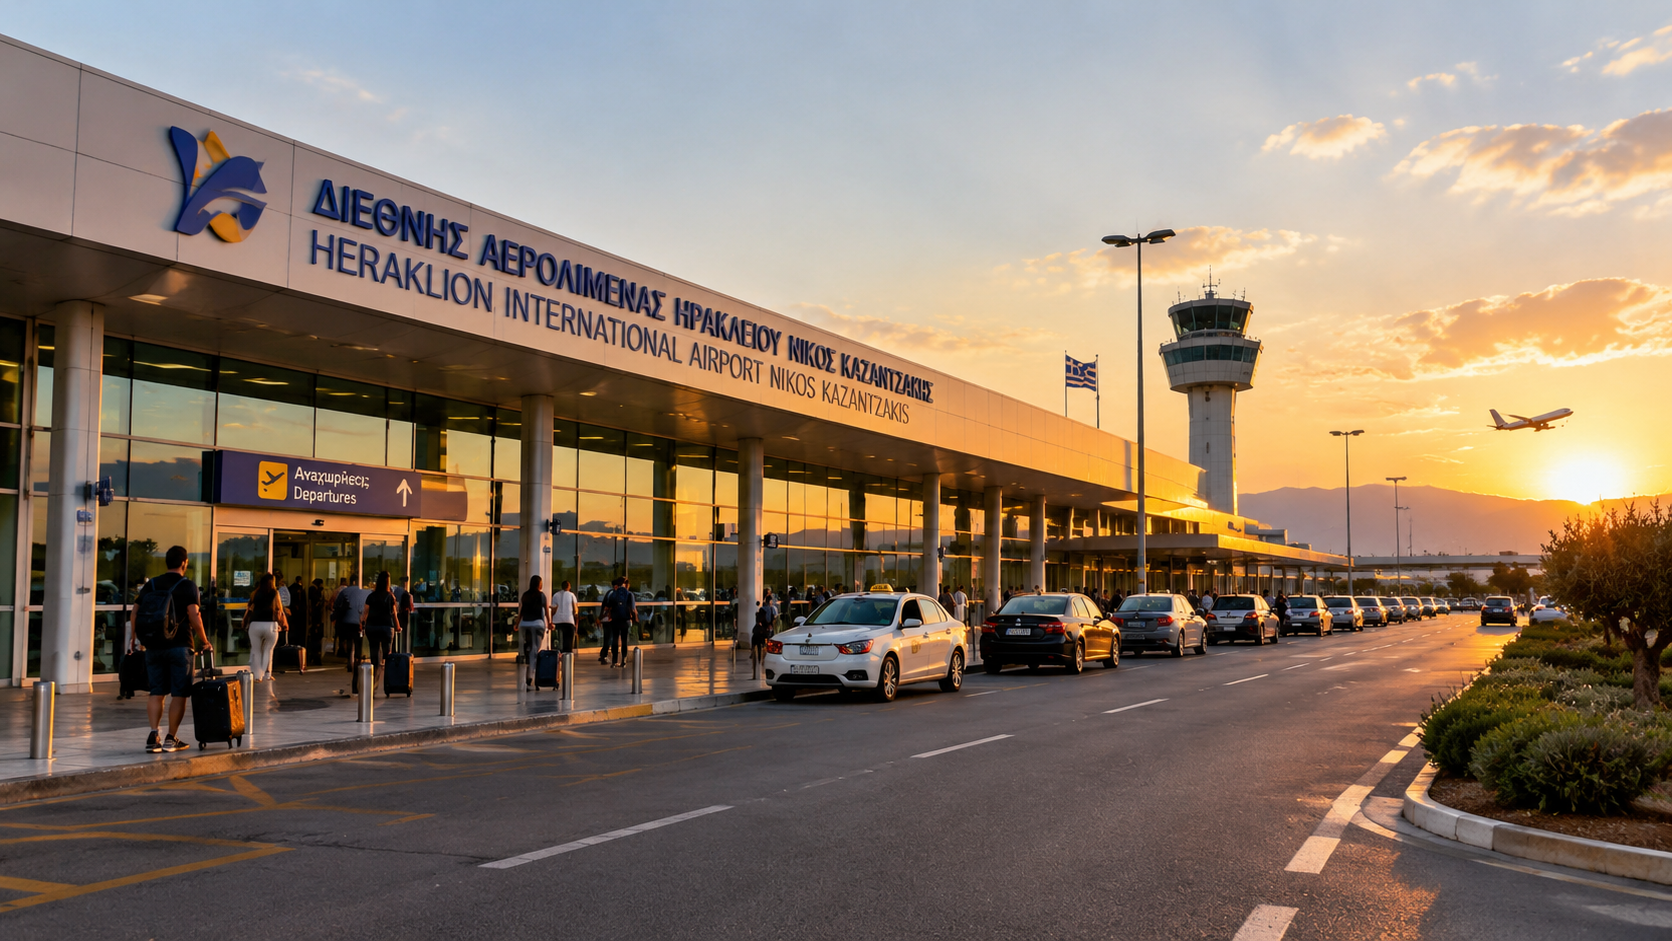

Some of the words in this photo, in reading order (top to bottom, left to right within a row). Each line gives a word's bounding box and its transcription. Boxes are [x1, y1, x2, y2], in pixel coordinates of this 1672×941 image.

[311, 229, 493, 313] HERAKLION
[505, 286, 682, 364] INTERNATIONAL
[689, 342, 764, 384] AIRPORT
[770, 364, 816, 399] NIKOS
[822, 379, 910, 424] KAZANTZAKIS
[312, 179, 469, 260] ΔΙΕΘΝΗΣ
[480, 233, 667, 321] ΑΕΡΟΛΙΜΕΝΑΣ
[674, 297, 782, 356] ΗΡΑΚΛΕΙΟΥ
[788, 335, 837, 374] ΝΙΚΟΣ
[840, 352, 934, 404] ΚΑΖΑΝΤΖΑΚΗΣ
[294, 485, 357, 505] Departures
